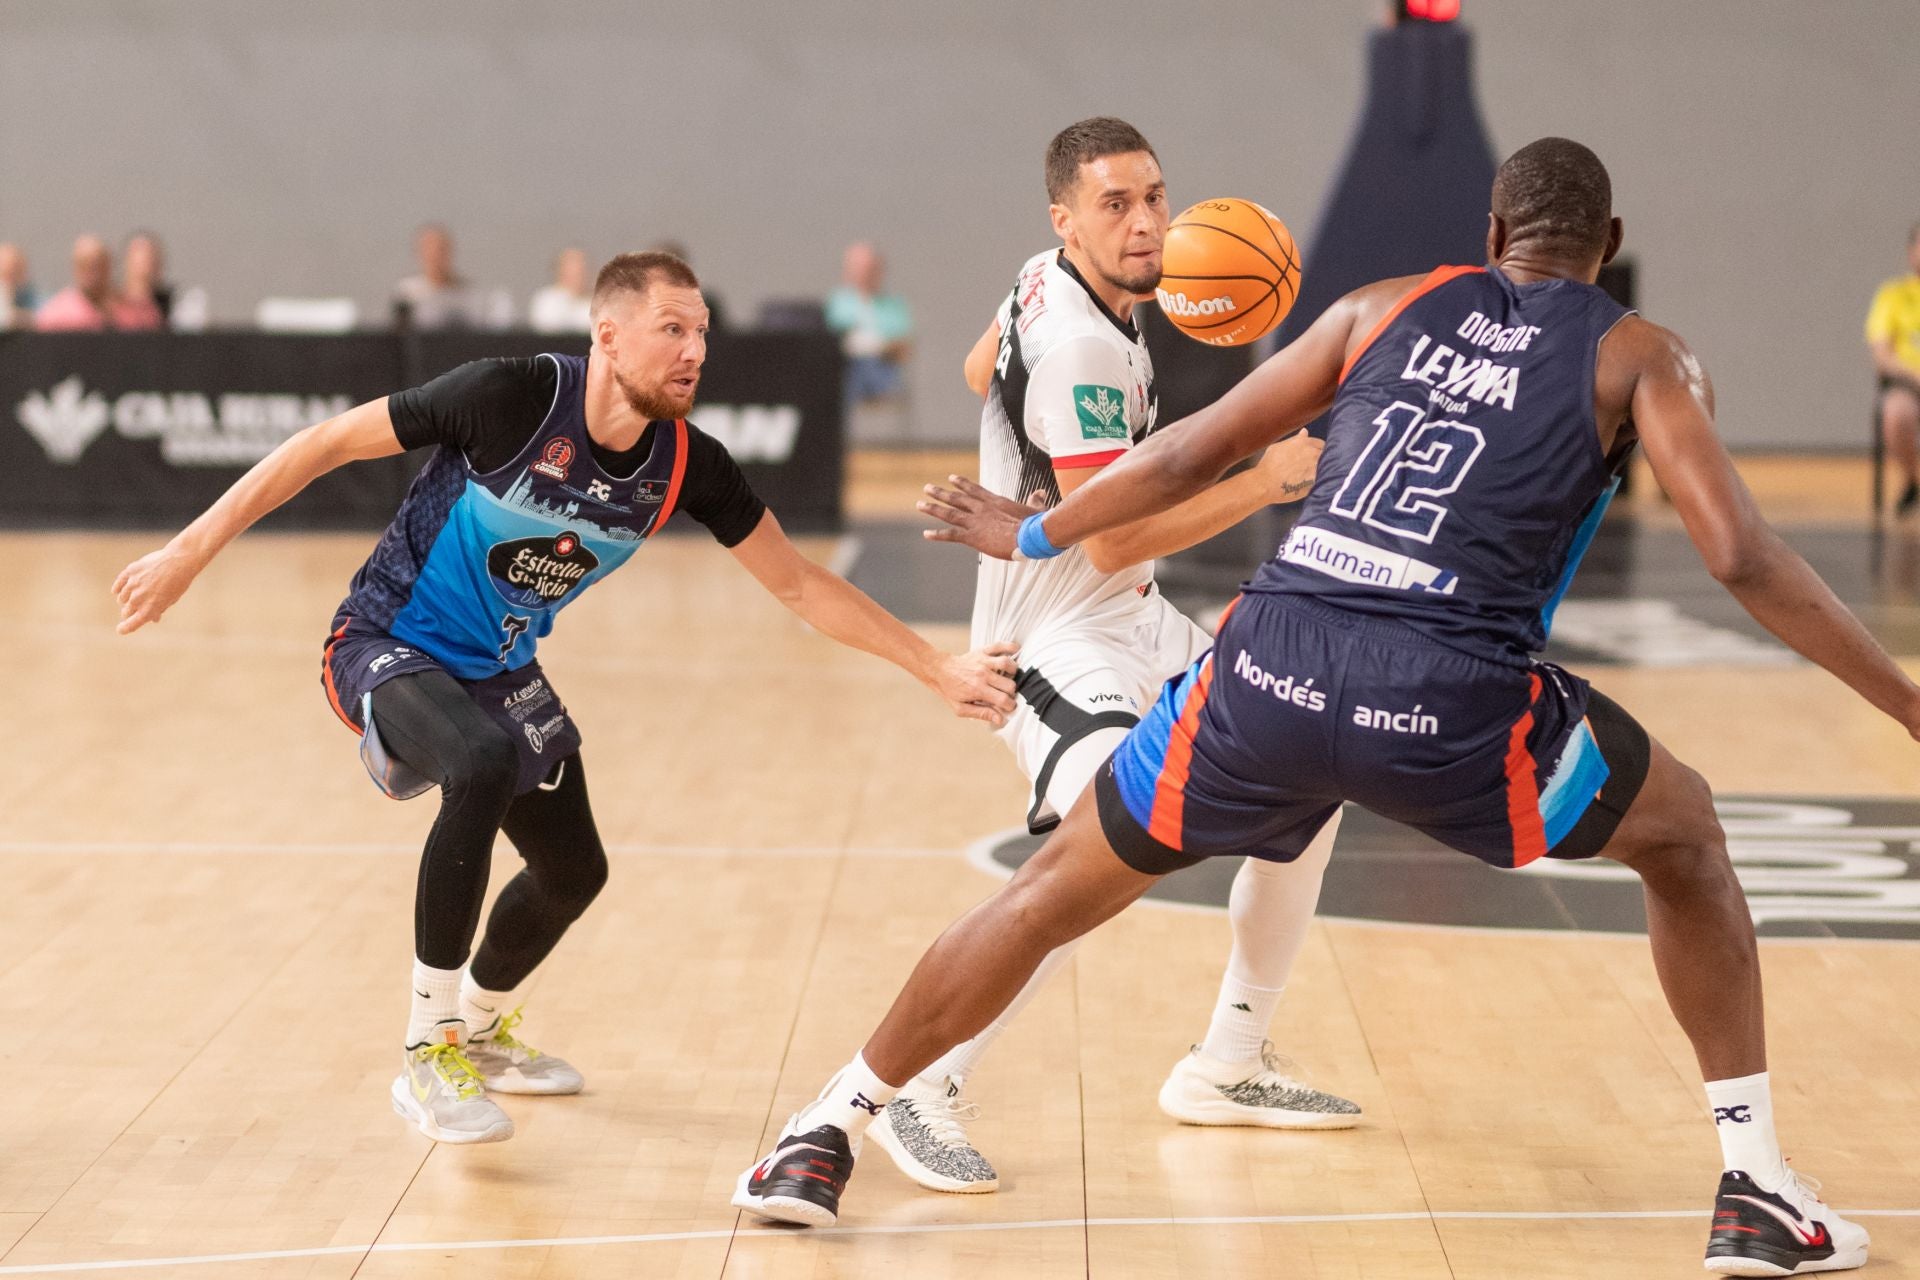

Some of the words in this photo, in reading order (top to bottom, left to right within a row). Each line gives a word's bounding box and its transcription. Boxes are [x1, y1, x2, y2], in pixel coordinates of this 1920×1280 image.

[1428, 389, 1470, 414] NATURA
[1328, 400, 1486, 545] 12
[512, 548, 586, 579] Estrella
[1292, 534, 1393, 585] Aluman
[497, 613, 531, 663] 7
[1089, 692, 1124, 703] vive
[1234, 649, 1327, 712] Nordés
[1353, 704, 1439, 735] ancín
